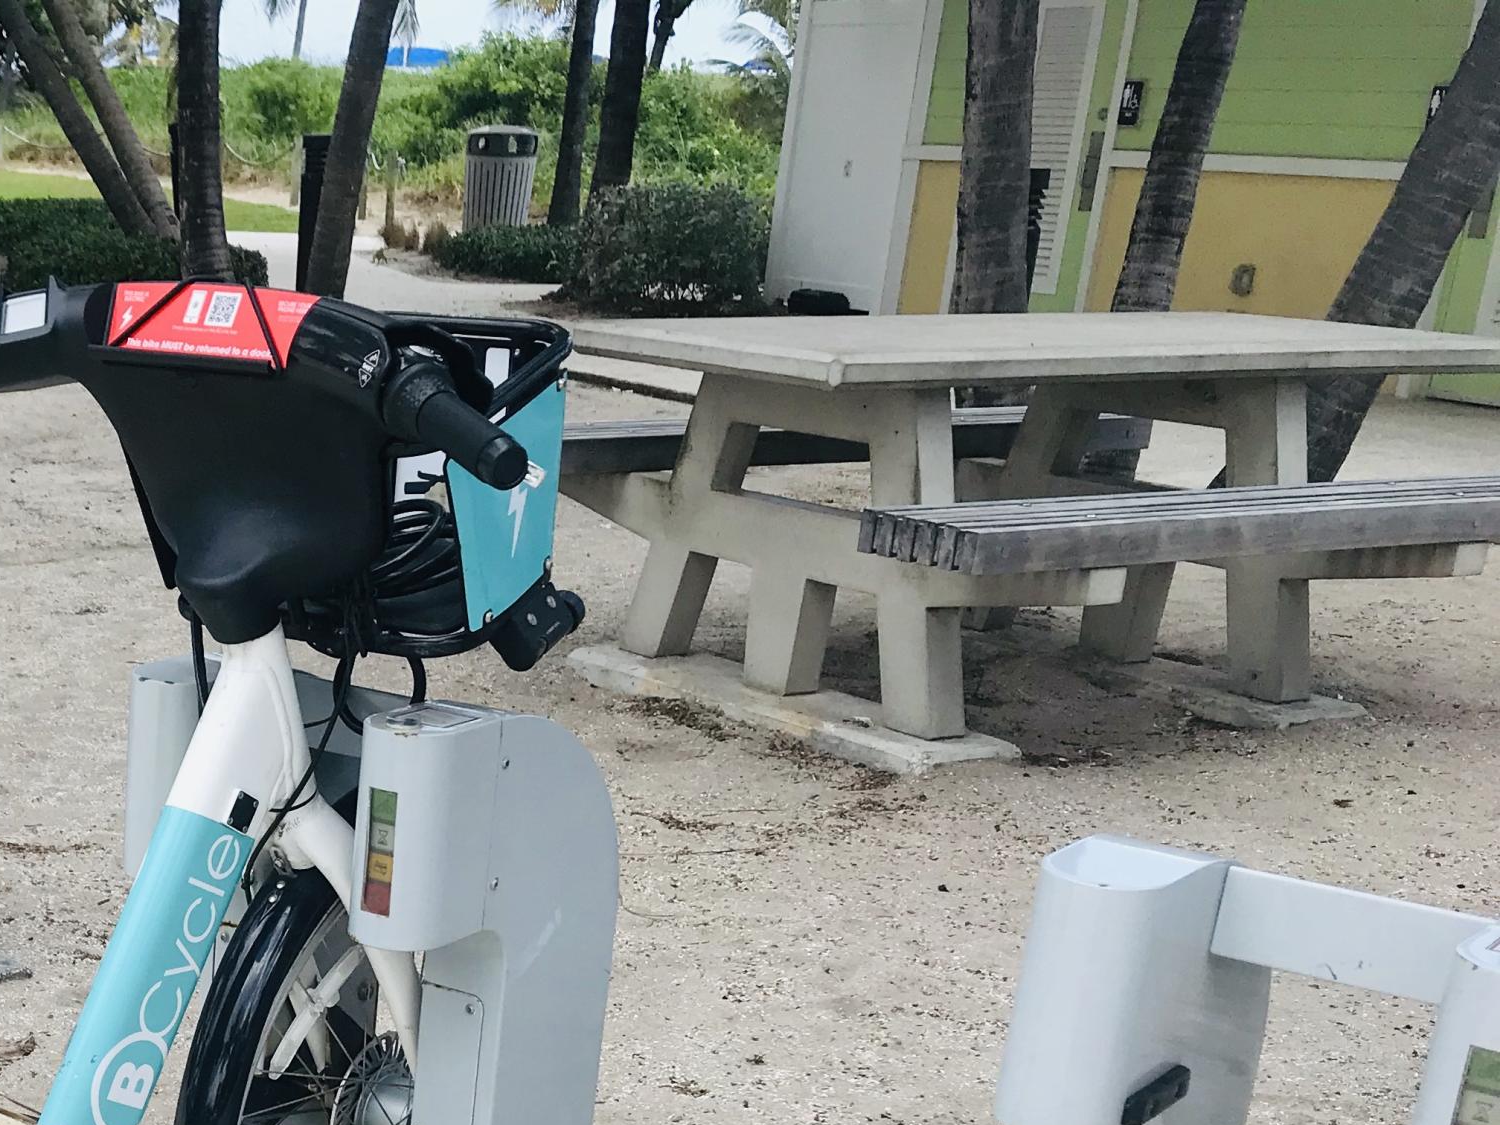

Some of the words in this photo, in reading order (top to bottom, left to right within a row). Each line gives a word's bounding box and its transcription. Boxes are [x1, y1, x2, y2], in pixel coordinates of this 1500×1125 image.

[127, 337, 142, 347] This
[160, 340, 184, 351] MUST
[183, 342, 195, 352] be
[195, 344, 231, 355] returned
[231, 346, 241, 355] to
